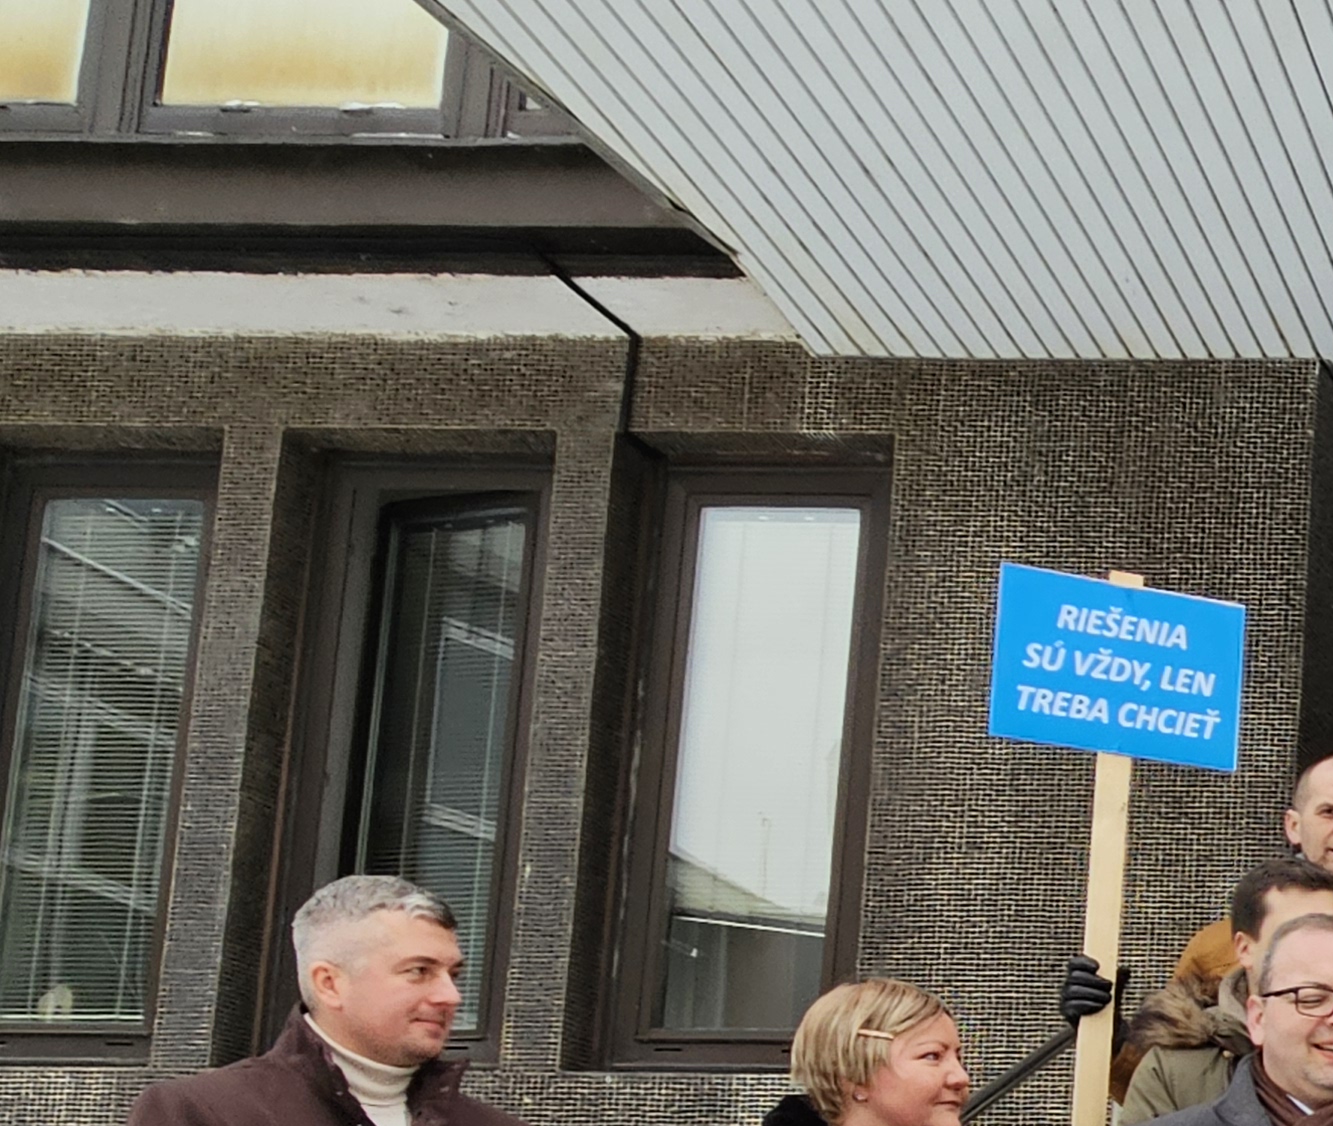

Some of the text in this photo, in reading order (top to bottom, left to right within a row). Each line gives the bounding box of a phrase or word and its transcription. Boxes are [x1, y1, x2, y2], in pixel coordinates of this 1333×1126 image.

[1056, 603, 1188, 650] RIEŠENIA
[1022, 638, 1216, 697] SÚ VŽDY, LEN
[1017, 685, 1221, 740] TREBA CHCIEŤ
